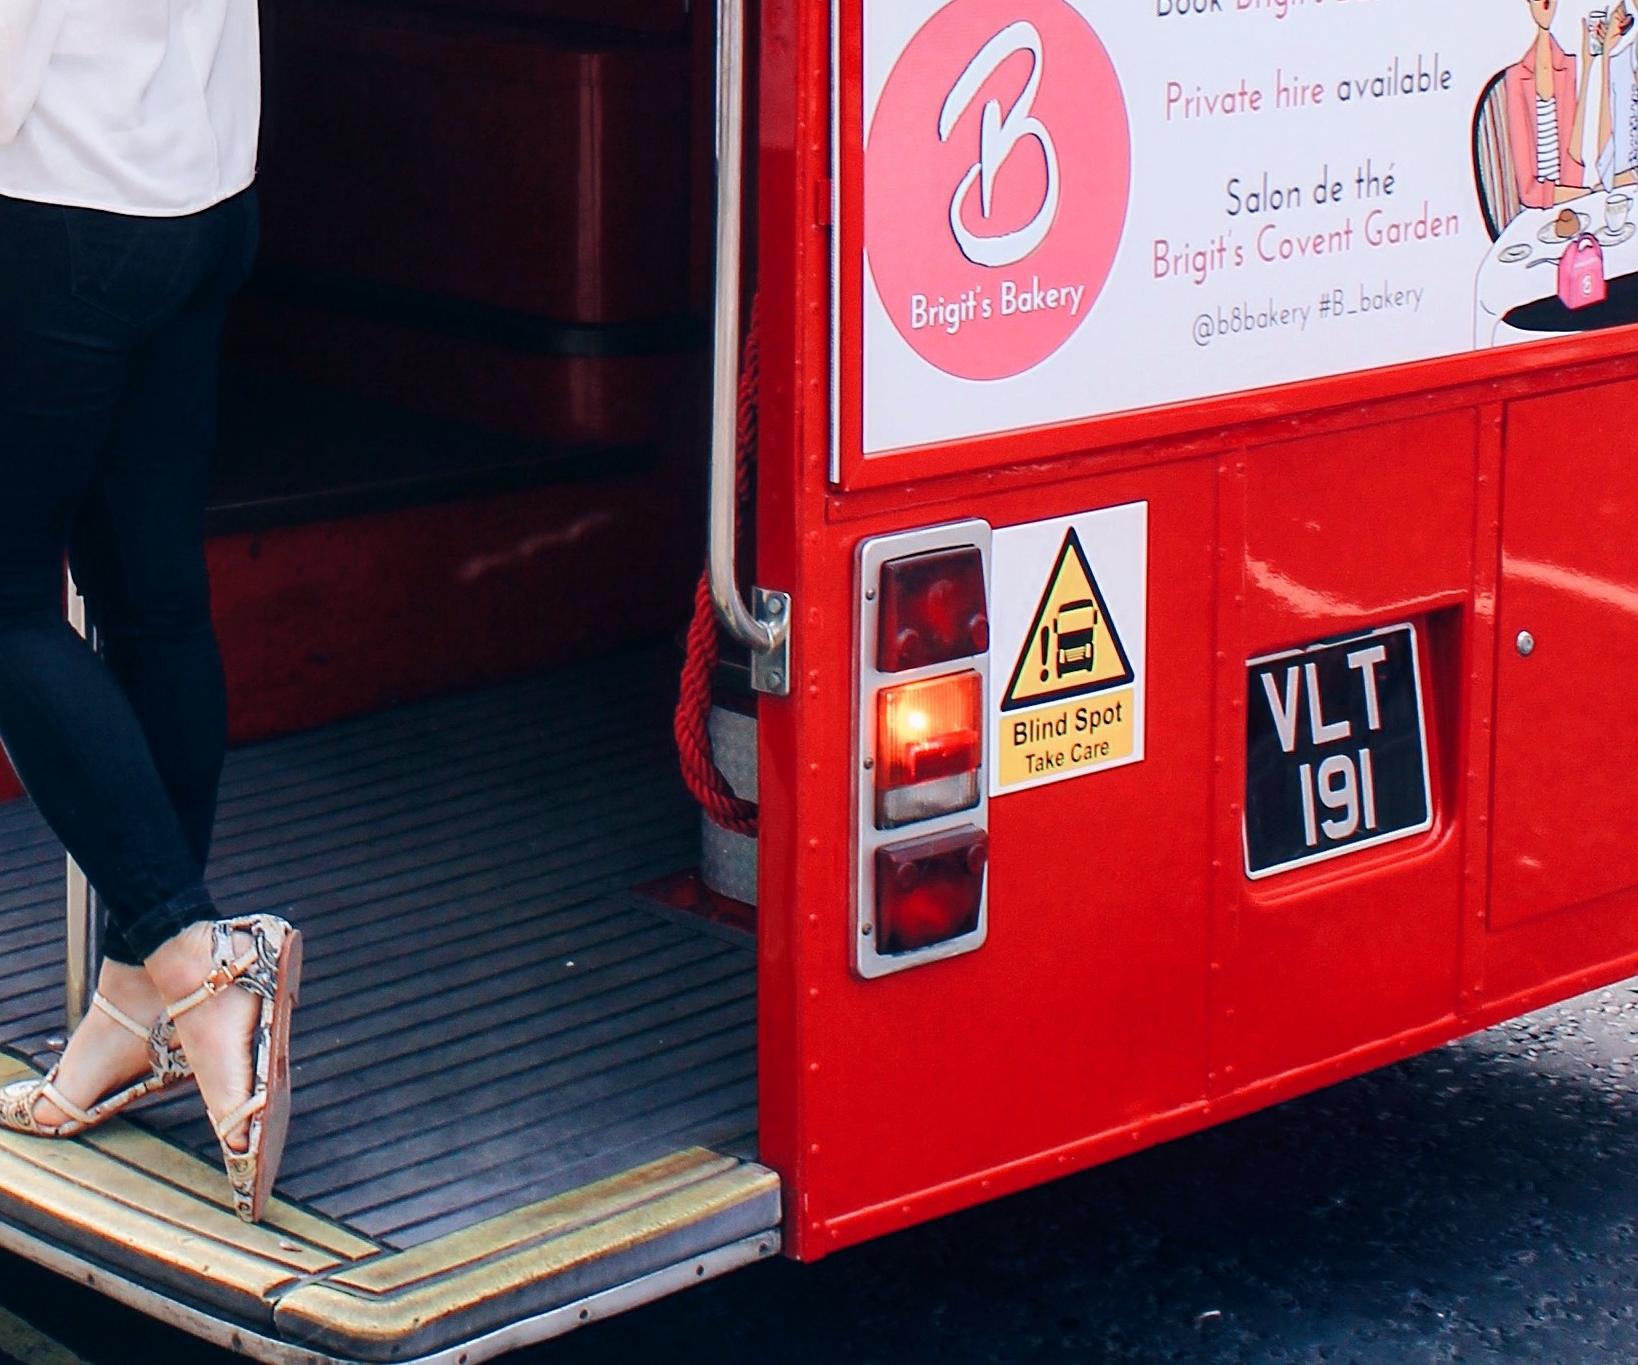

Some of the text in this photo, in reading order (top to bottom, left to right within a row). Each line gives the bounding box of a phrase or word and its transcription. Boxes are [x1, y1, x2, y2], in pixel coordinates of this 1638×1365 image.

[1166, 52, 1452, 121] Private hire available
[937, 19, 1061, 268] B
[1226, 158, 1396, 216] Salon de thé
[1153, 200, 1459, 286] Brigit's Covent Garden
[911, 275, 1086, 335] Brigit's Bakery
[1192, 279, 1425, 347] @b8bakery #B_bakery
[1013, 701, 1122, 747] Blind Spot
[1260, 644, 1388, 754] VLT
[1025, 741, 1110, 774] Take Care
[1298, 747, 1378, 848] 191
